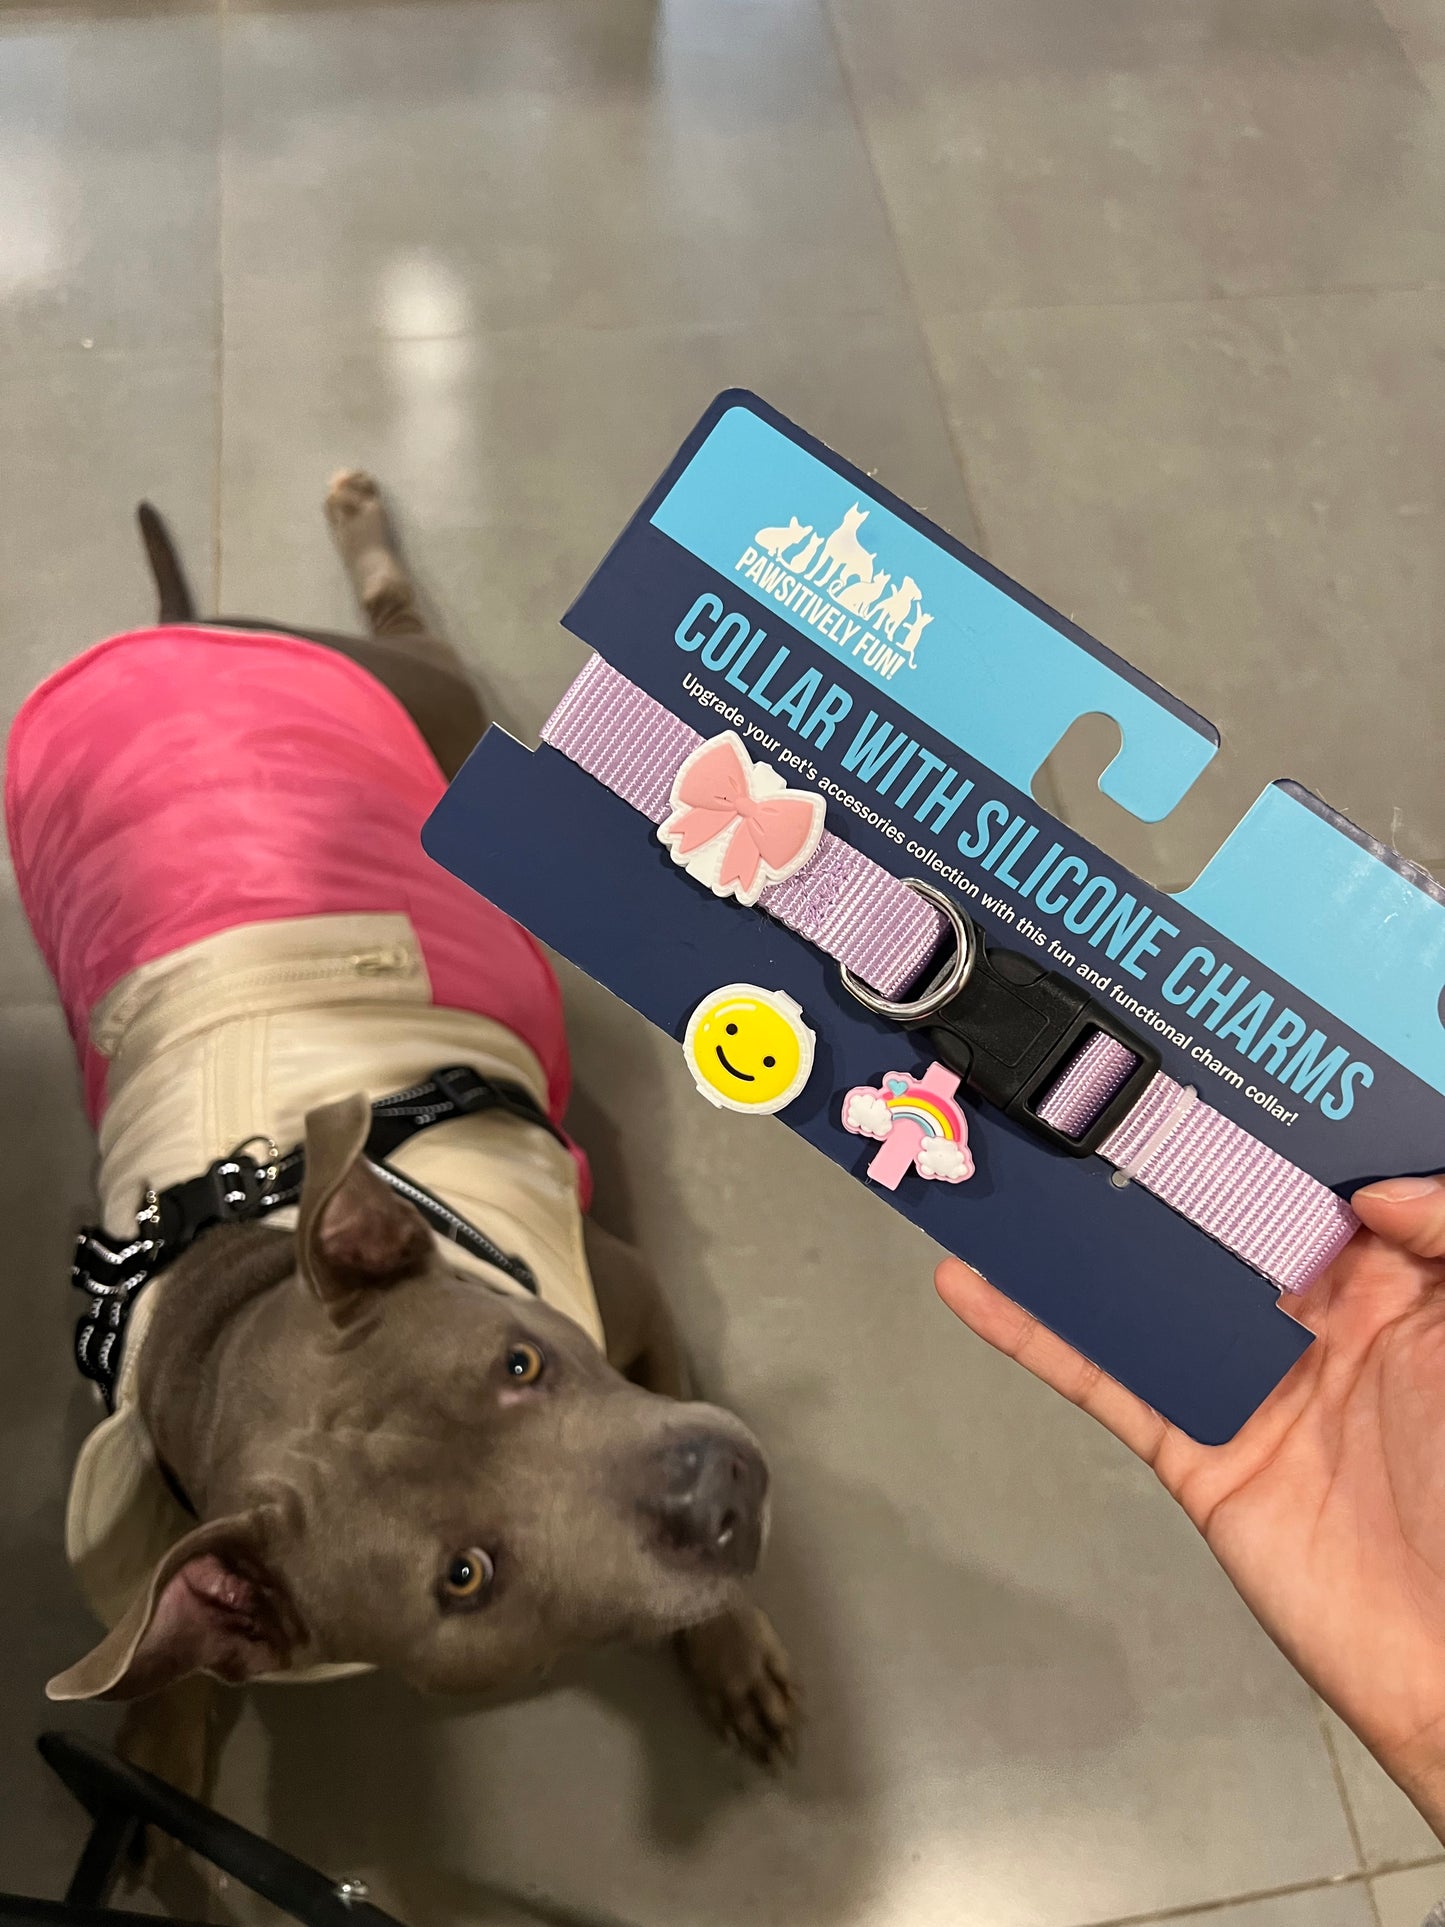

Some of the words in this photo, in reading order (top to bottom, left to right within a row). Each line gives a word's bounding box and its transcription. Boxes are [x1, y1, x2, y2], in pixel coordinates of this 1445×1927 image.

[734, 546, 858, 647] PAWSITIVELY
[852, 632, 906, 680] FUN!
[674, 592, 854, 751] COLLAR
[840, 709, 975, 835] WITH
[957, 799, 1180, 981] SILICONE
[1161, 946, 1375, 1121] CHARMS
[682, 672, 745, 727] Upgrade
[742, 721, 781, 752] your
[777, 748, 818, 781] pet's
[817, 776, 906, 844] accessories
[906, 840, 980, 898] collection
[981, 893, 1016, 924] with
[1015, 917, 1048, 946] this
[1047, 939, 1076, 972] fun
[1076, 963, 1113, 992] and
[1109, 984, 1194, 1050] functional
[1190, 1046, 1245, 1089] charm
[1244, 1085, 1299, 1127] collar!
